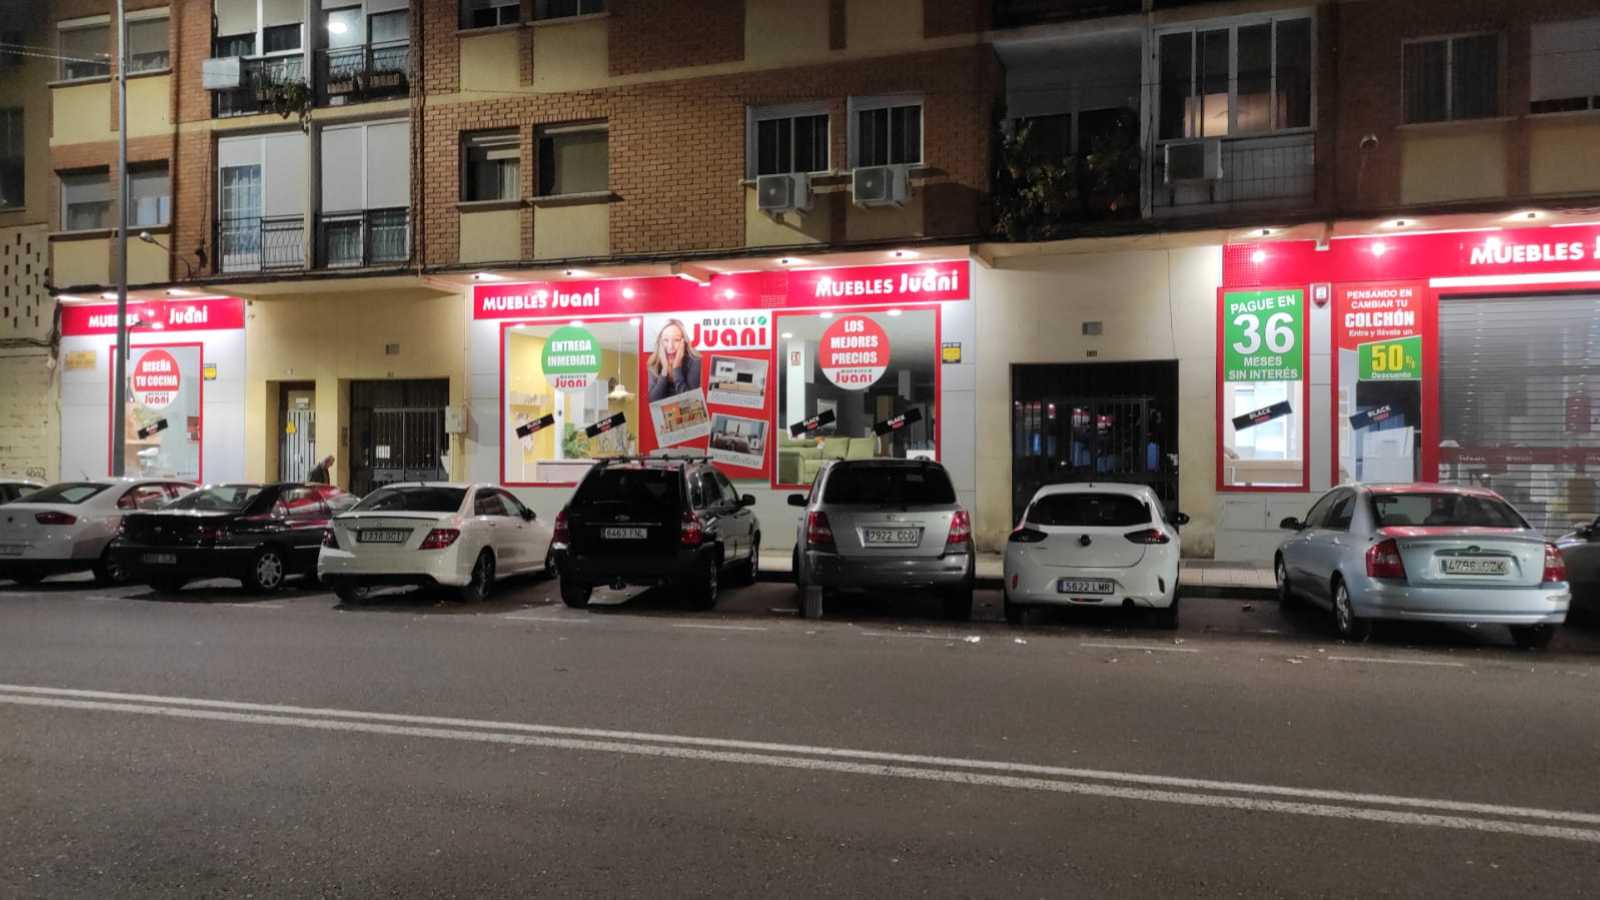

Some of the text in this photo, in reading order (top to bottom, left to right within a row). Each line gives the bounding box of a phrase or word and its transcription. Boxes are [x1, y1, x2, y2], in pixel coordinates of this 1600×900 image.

[1470, 241, 1585, 265] MUEBLES
[815, 269, 959, 298] MUEBLES Juani
[482, 287, 600, 311] MUEBLES Juani
[1347, 289, 1413, 299] PENSANDO EN
[1230, 294, 1296, 315] PAGUE EN
[1351, 299, 1408, 309] CAMBIAR TU
[169, 305, 208, 325] Juani
[703, 316, 756, 326] MUEBLES
[1345, 308, 1415, 328] COLCHÓN
[844, 320, 864, 332] LOS
[691, 323, 766, 348] Juani
[1233, 312, 1295, 354] 36
[1349, 329, 1369, 337] Entra
[1370, 329, 1375, 338] y
[551, 340, 592, 352] ENTREGA
[831, 335, 878, 348] MEJORES
[548, 355, 596, 367] INMEDIATA
[832, 352, 878, 365] PRECIOS
[1243, 356, 1283, 367] MESES
[142, 360, 171, 372] DISEÑA
[835, 372, 873, 383] Juani
[1228, 367, 1298, 380] SIN INTERÉS
[1371, 371, 1412, 379] Descuento
[136, 374, 178, 387] TU COCINA
[554, 377, 588, 388] Juani
[145, 395, 170, 405] Juani
[1367, 405, 1391, 417] BLACK
[870, 531, 893, 541] 7922
[1448, 561, 1477, 571] 4796
[1066, 582, 1110, 592] 5622 LMR
